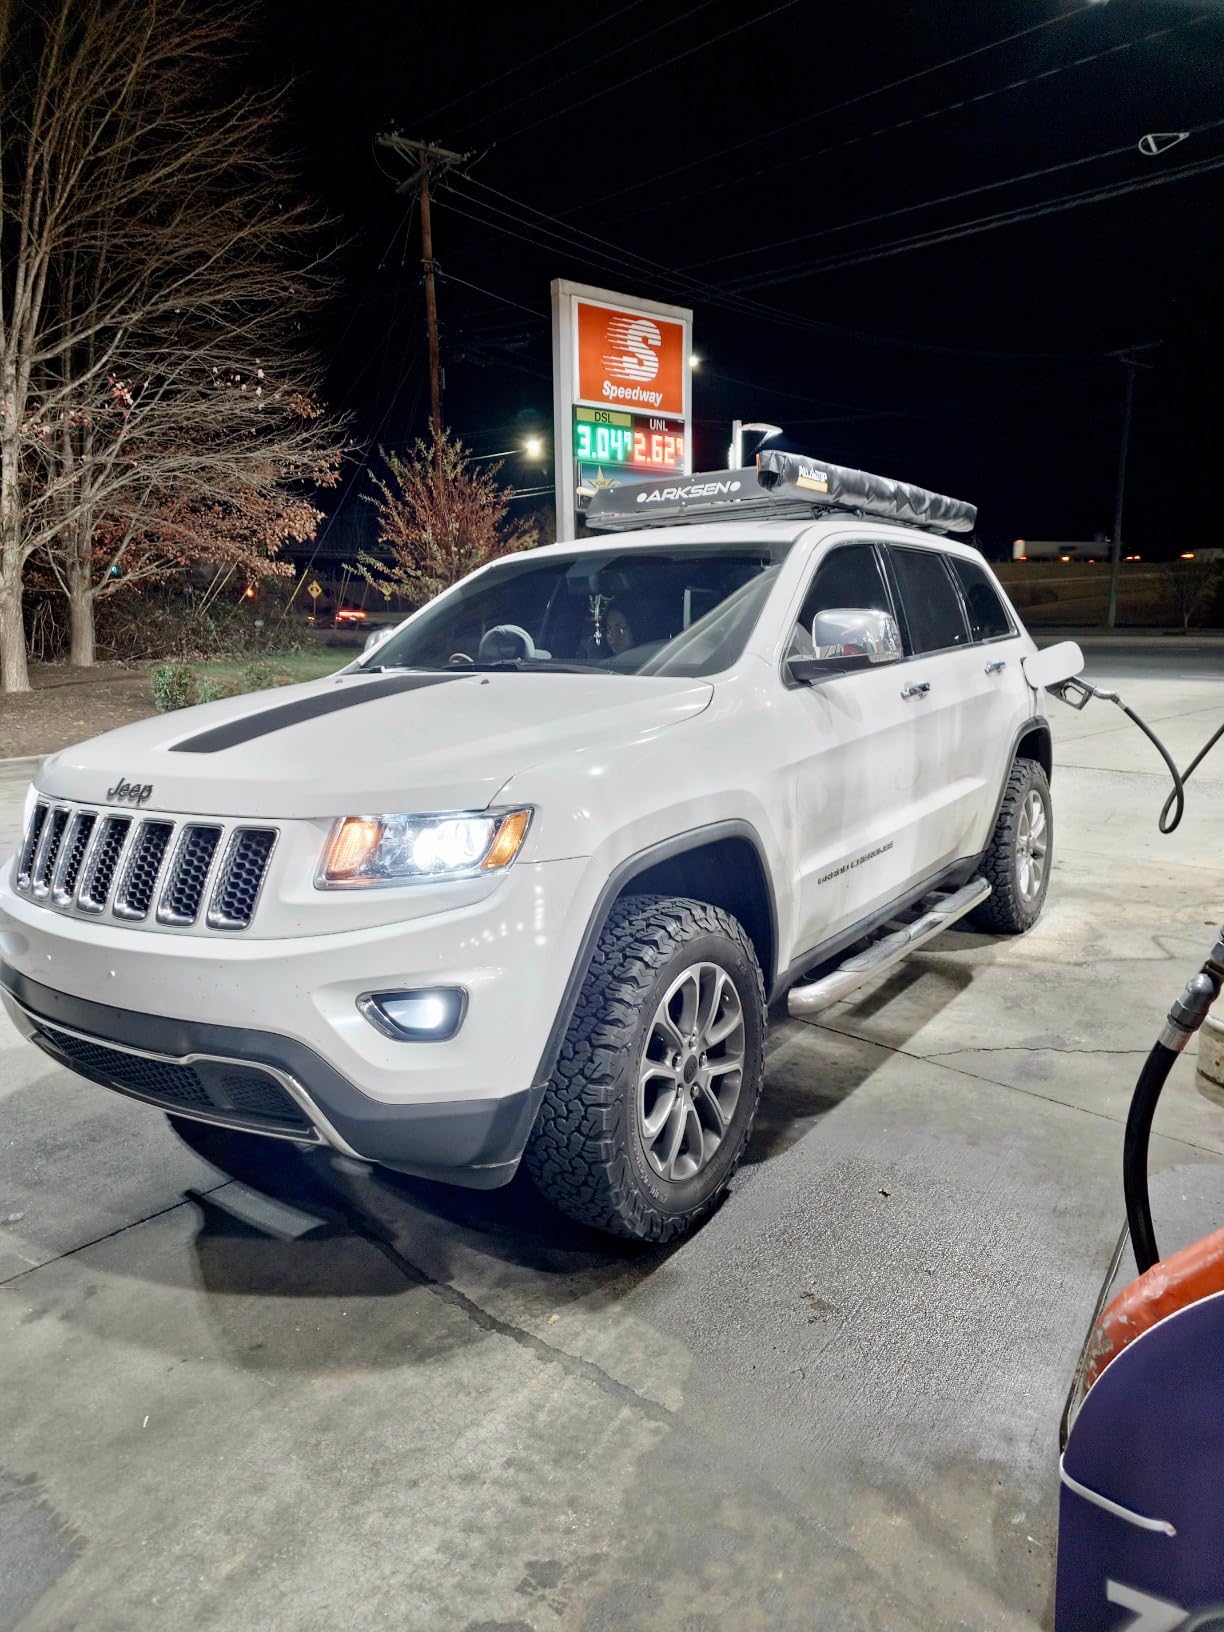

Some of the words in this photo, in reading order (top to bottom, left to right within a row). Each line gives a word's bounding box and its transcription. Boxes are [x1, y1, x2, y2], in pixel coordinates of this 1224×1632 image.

[602, 380, 663, 406] Speedway
[594, 411, 613, 424] DSL
[649, 418, 669, 432] UNL
[644, 481, 731, 503] ARKSEN
[106, 777, 153, 804] Jeep
